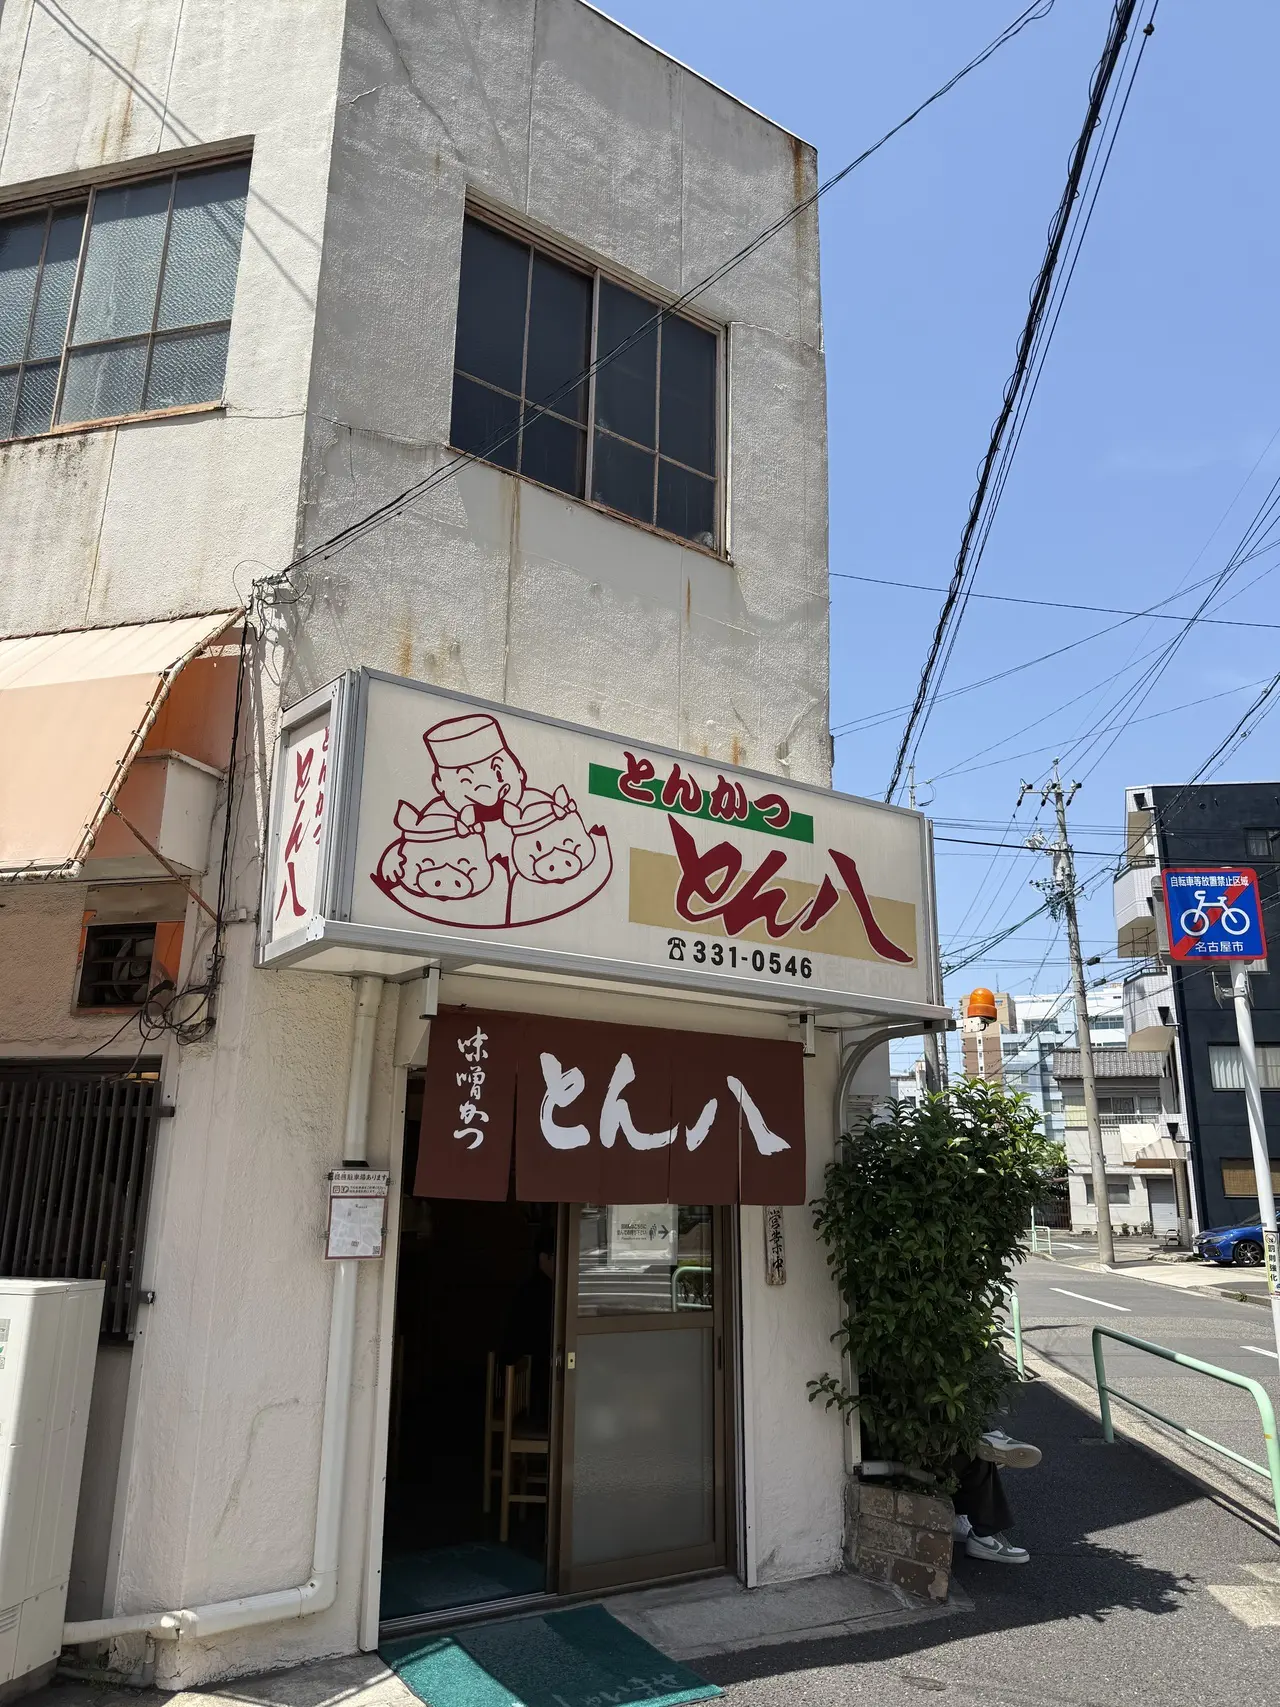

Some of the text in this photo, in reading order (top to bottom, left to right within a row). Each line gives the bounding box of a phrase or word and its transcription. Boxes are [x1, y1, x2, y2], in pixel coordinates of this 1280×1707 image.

[275, 748, 314, 921] とん八
[618, 751, 791, 828] とんかつ
[668, 814, 914, 964] とん八
[1170, 876, 1249, 887] 自転車等放置禁止区域
[693, 940, 812, 979] 331-0546
[1195, 941, 1244, 952] 名古屋市
[453, 1027, 489, 1149] 味噌かつ
[540, 1052, 792, 1156] とん八
